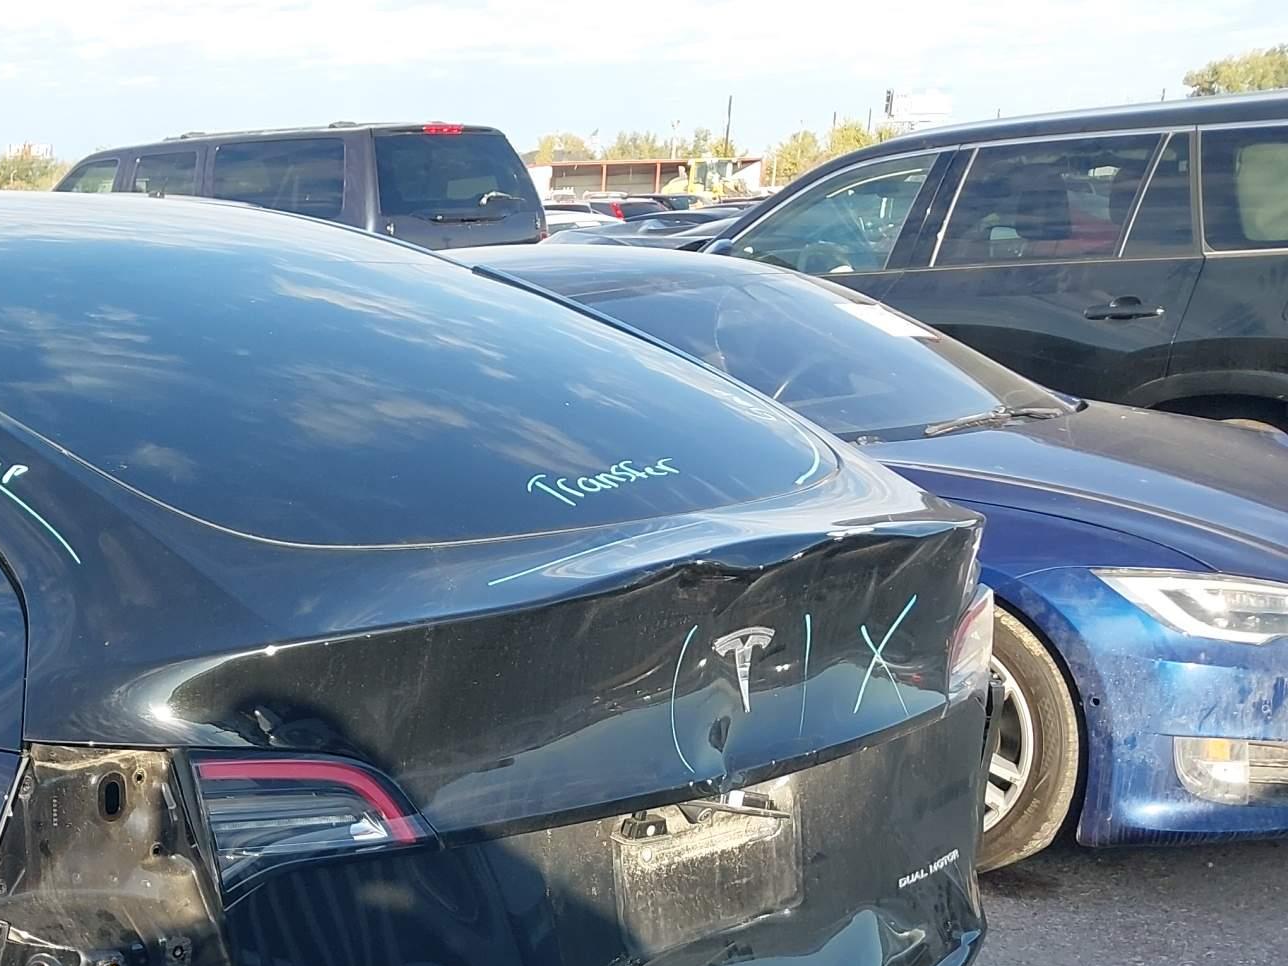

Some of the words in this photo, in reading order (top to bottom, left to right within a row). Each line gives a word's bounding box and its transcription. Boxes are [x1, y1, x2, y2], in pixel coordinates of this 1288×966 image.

[527, 457, 680, 507] Transfer
[898, 868, 929, 889] DUAL
[928, 848, 960, 875] MOTOR
